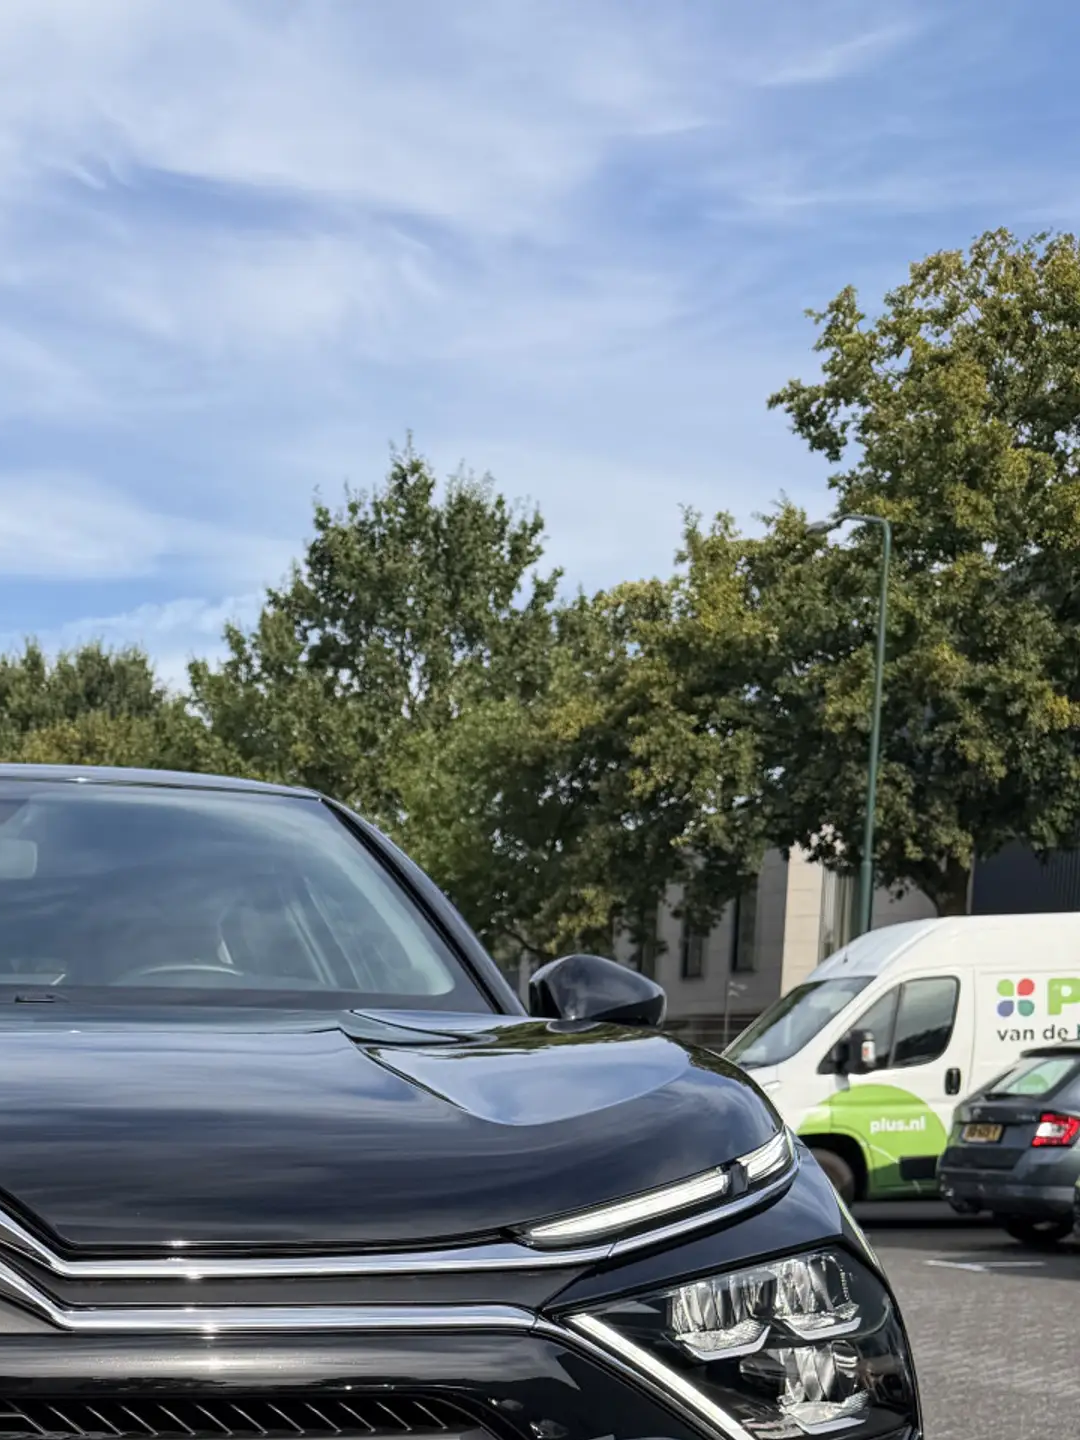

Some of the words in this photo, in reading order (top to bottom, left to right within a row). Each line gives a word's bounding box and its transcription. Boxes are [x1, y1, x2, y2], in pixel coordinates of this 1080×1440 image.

[997, 1028, 1035, 1041] van
[1042, 1023, 1068, 1041] de
[870, 1115, 926, 1134] plus.nl
